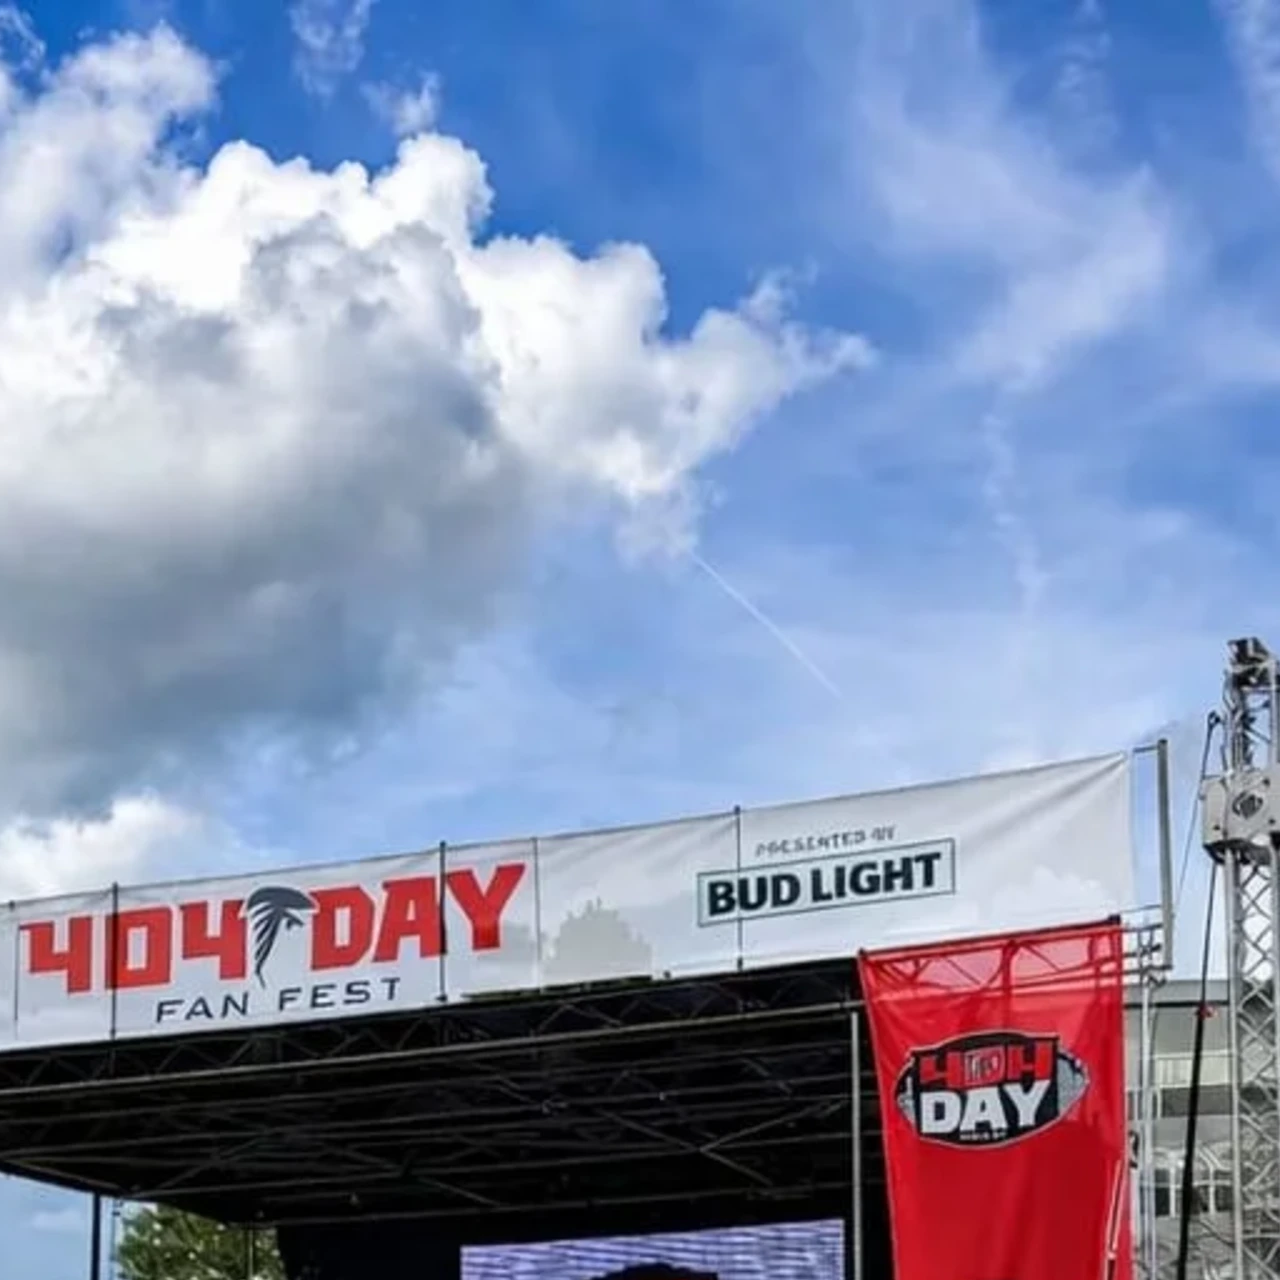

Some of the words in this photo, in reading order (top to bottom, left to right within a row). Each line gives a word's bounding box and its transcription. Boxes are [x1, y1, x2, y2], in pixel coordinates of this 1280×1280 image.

[707, 873, 800, 917] BUD
[811, 852, 941, 902] LIGHT
[20, 900, 247, 994] 404
[309, 863, 526, 972] DAY
[156, 992, 248, 1024] FAN
[279, 977, 401, 1012] FEST
[920, 1079, 1051, 1134] DAY
